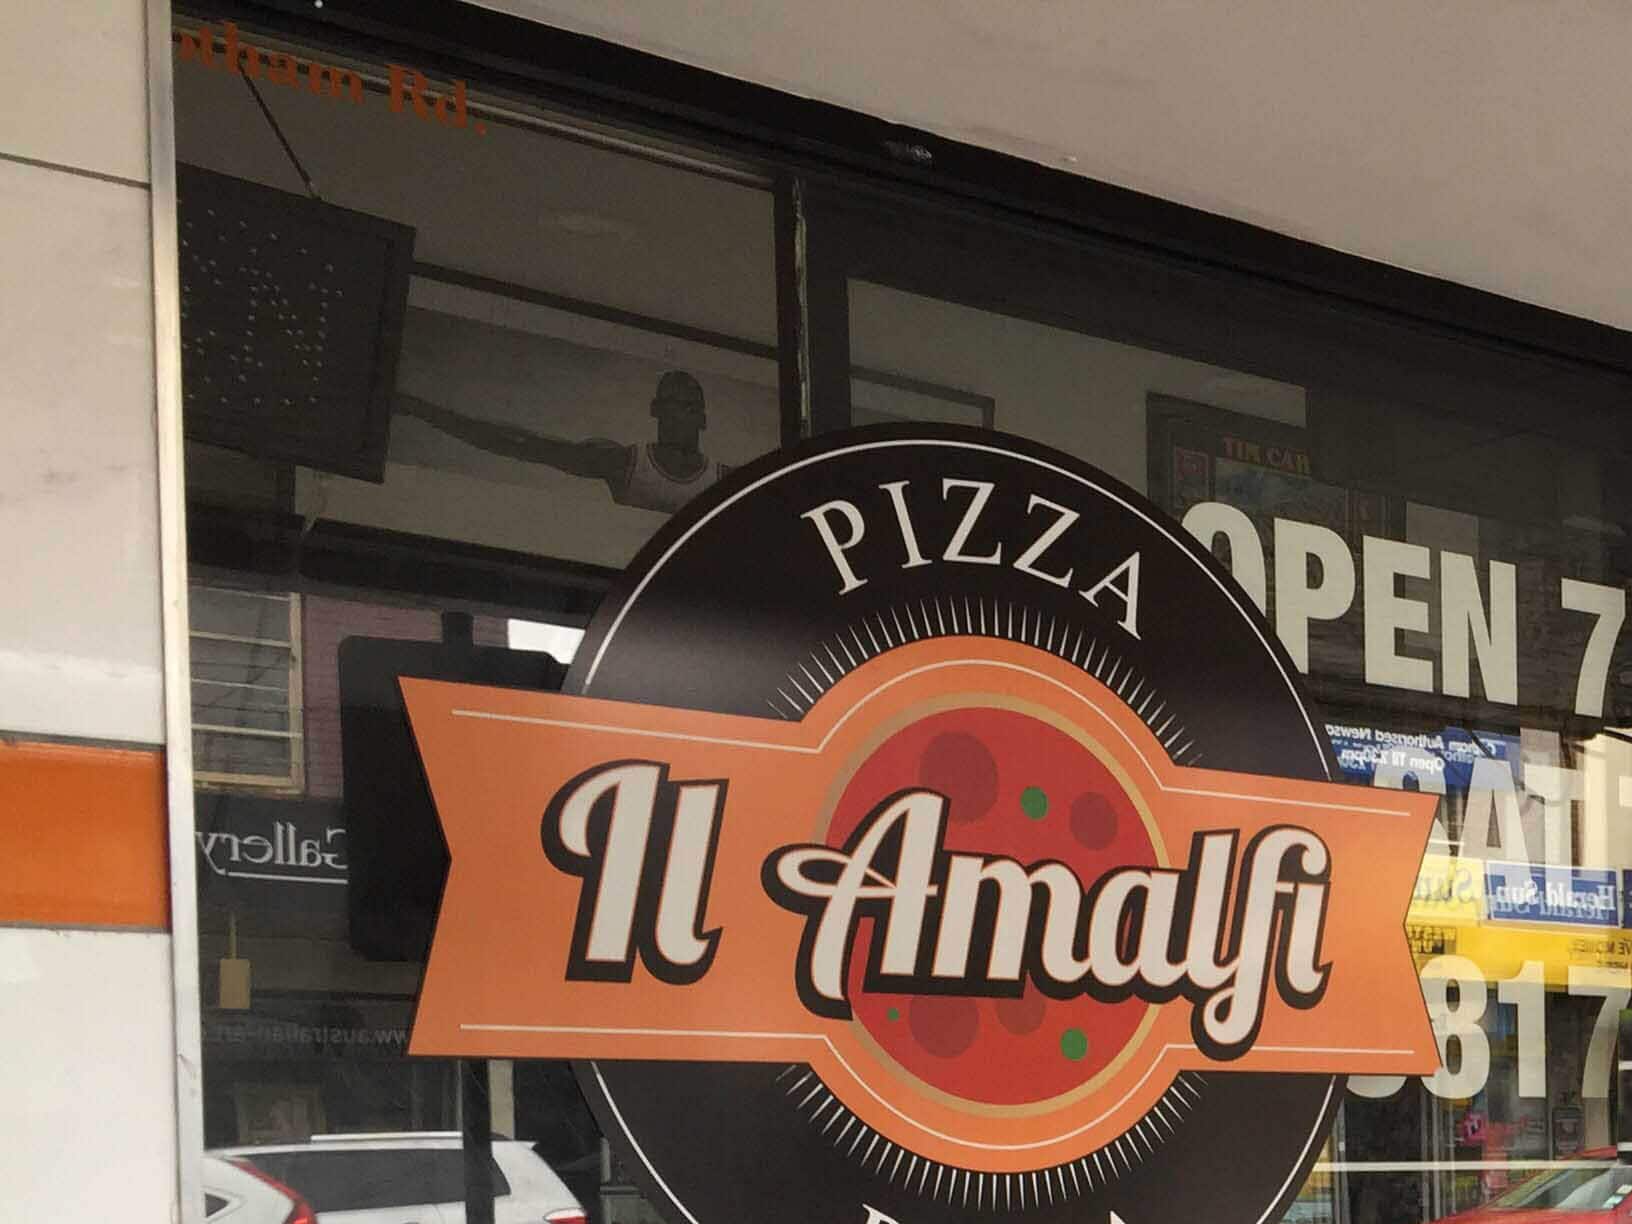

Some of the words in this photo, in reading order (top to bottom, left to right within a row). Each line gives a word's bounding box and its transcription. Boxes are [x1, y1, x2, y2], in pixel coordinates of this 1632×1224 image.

[386, 63, 487, 137] Rd.
[801, 477, 1145, 641] PIZZA
[1180, 500, 1518, 707] OPEN
[1560, 577, 1626, 718] 7
[541, 759, 728, 985] Il
[761, 787, 1333, 1060] Amalfi
[1346, 955, 1632, 1100] 817
